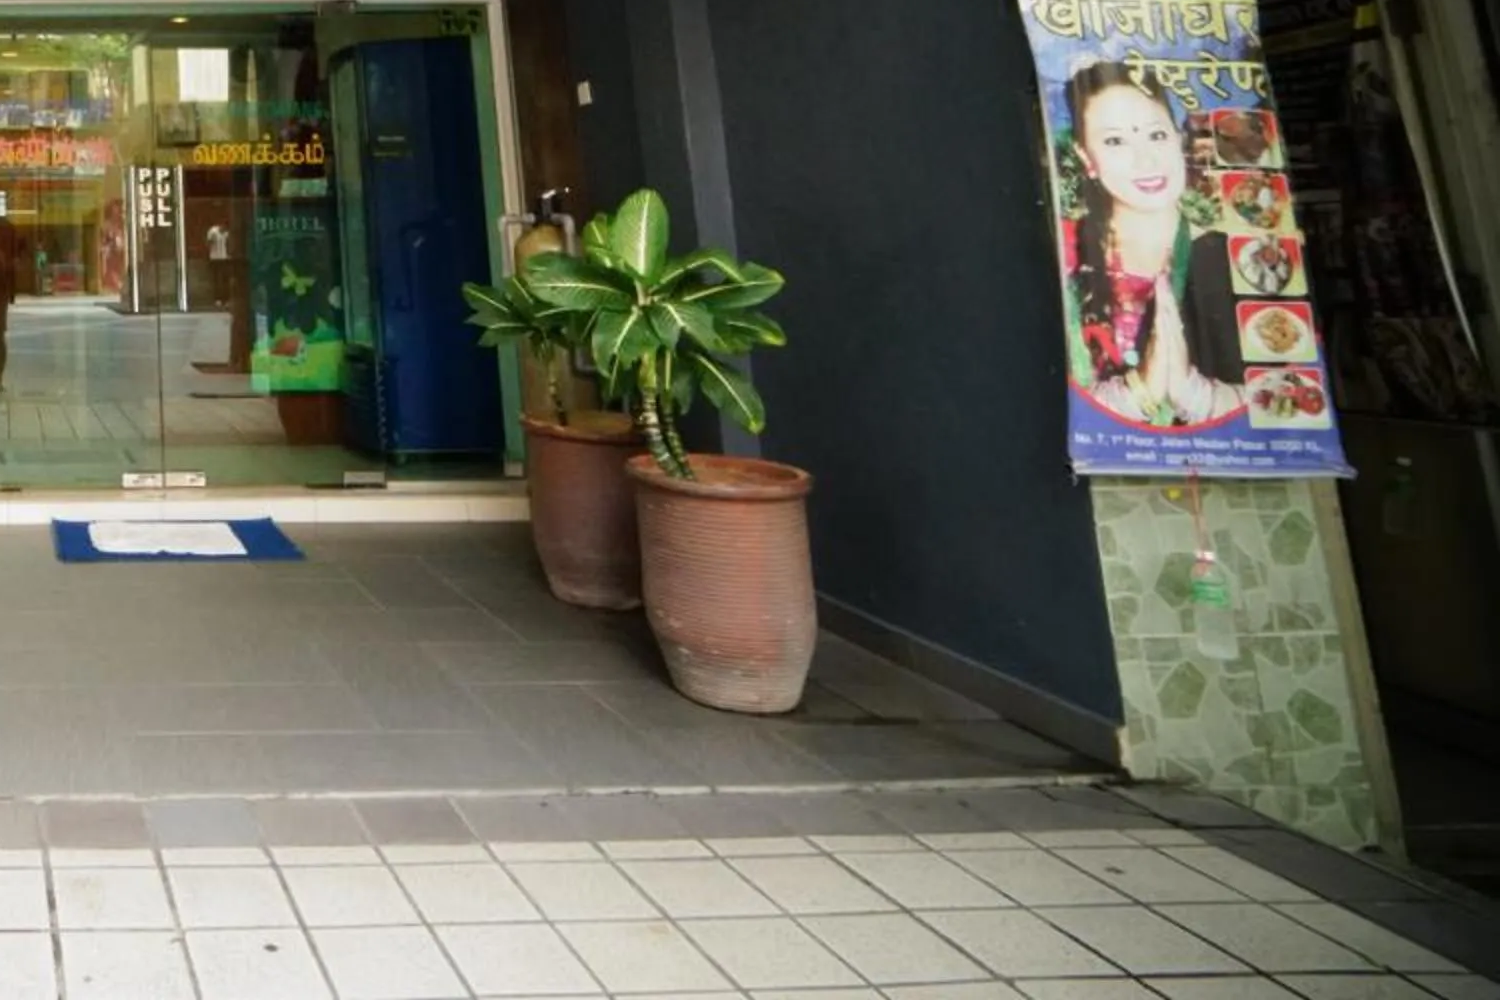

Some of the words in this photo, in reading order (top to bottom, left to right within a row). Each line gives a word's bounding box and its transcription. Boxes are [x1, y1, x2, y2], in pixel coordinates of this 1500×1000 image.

[193, 133, 325, 165] வணக்கம்
[138, 167, 155, 228] PUSH
[155, 167, 173, 227] PULL
